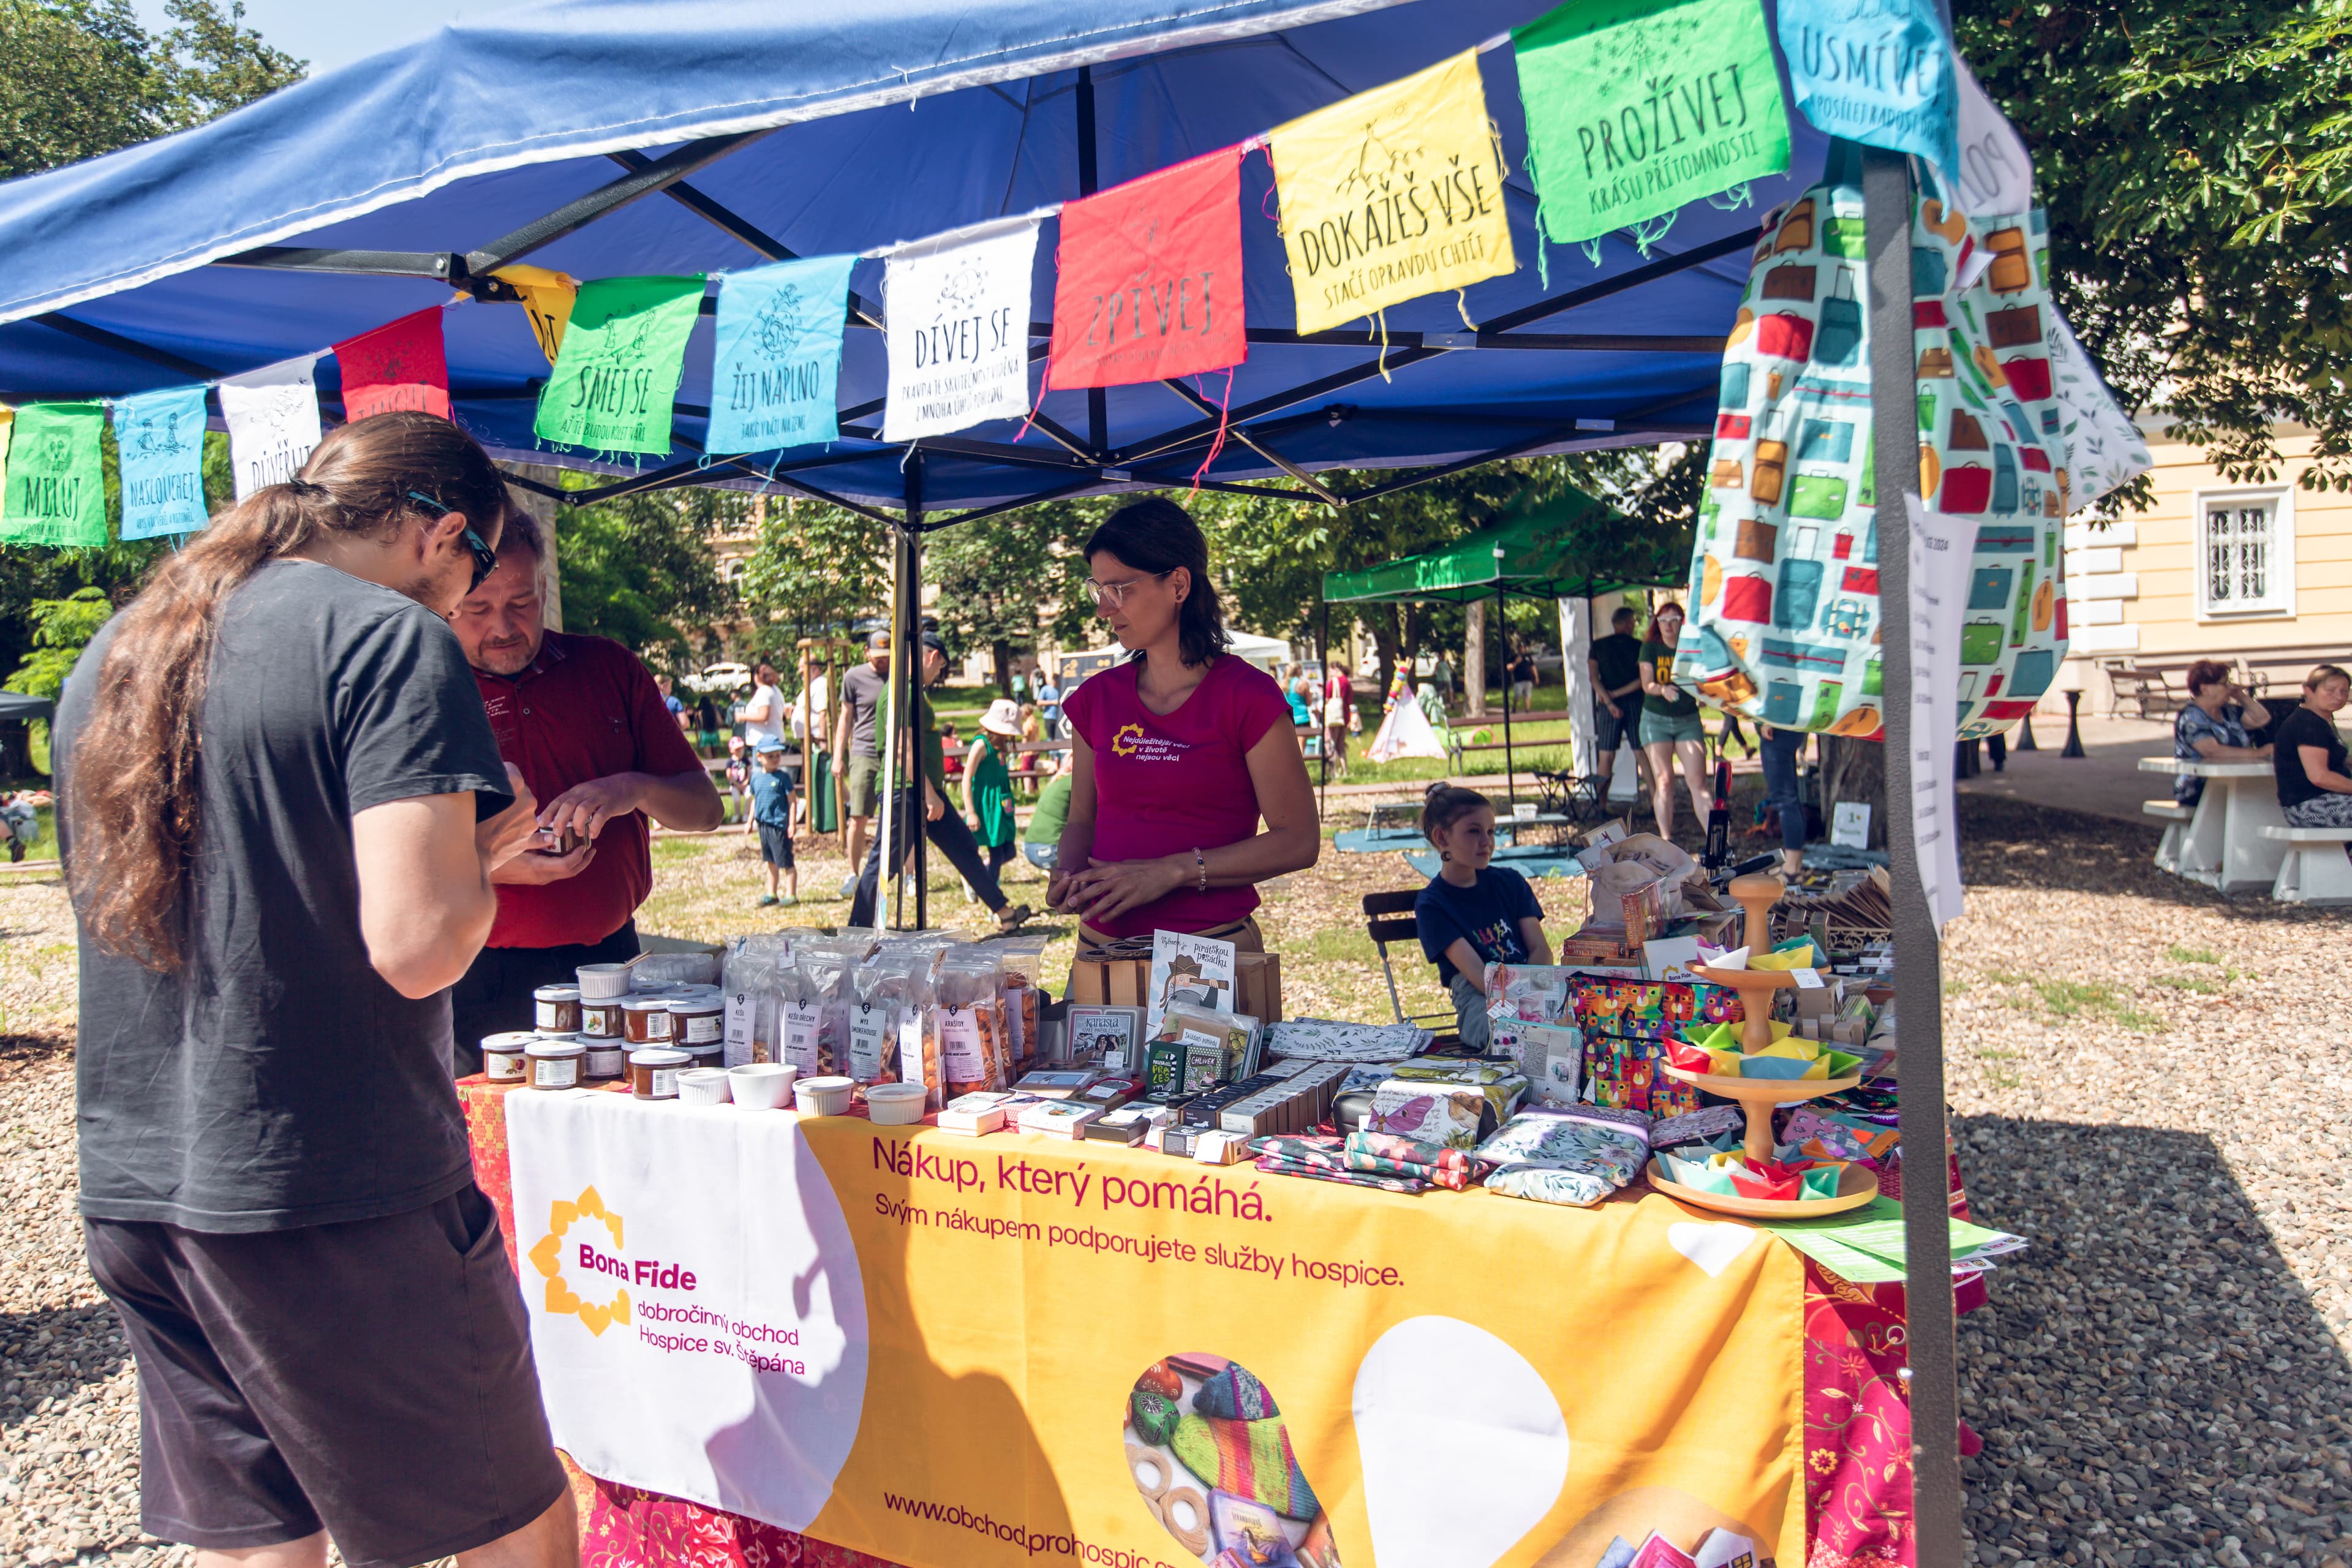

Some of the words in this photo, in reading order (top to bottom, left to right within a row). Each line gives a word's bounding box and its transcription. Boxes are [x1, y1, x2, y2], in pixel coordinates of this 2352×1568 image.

[1577, 64, 1747, 179] PROŽÍVEJ
[1817, 94, 1866, 125] POSÍLEJ
[1588, 175, 1643, 216] KRÁSU
[1645, 130, 1759, 197] PŘÍTOMNOSTI
[1300, 171, 1428, 277] DOKÁŽEŠ
[1431, 154, 1492, 226] VŠE
[1324, 265, 1366, 310] STAČÍ
[1369, 250, 1438, 291] OPRAVDU
[1441, 232, 1485, 266] CHTÍT
[1087, 270, 1215, 347] ZPÍVEJ
[915, 312, 982, 369] DÍVEJ
[990, 307, 1011, 352] SE
[570, 353, 629, 418] SMĚJ
[630, 366, 654, 414] SE
[731, 361, 757, 413] ŽIJ
[761, 361, 821, 408] NAPLNO
[902, 381, 932, 402] PRAVDA
[584, 423, 609, 440] BUDOU
[741, 421, 760, 440] JAKO
[922, 401, 952, 420] MNOHA
[24, 475, 80, 519] MILUJ
[129, 472, 195, 508] NASLOUCHEJ
[1123, 735, 1172, 746] Nejdůležitější
[1136, 753, 1161, 762] nejsou
[788, 1012, 798, 1020] KEŠU
[799, 1013, 815, 1022] OŘECHY
[851, 1025, 877, 1036] SMOKEHOUSE
[873, 1136, 986, 1193] Nákup,
[998, 1155, 1091, 1207] který
[1102, 1175, 1273, 1223] pomáhá.
[875, 1192, 928, 1226] Svým
[936, 1206, 1041, 1242] nákupem
[1049, 1225, 1197, 1265] podporujete
[1204, 1243, 1285, 1281] služby
[1292, 1251, 1405, 1289] hospice.
[579, 1243, 629, 1282] Bona
[635, 1259, 697, 1291] Fide
[638, 1300, 729, 1333] dobročinný
[732, 1321, 799, 1346] obchod
[640, 1324, 709, 1353] Hospice
[714, 1339, 735, 1357] sv.
[736, 1340, 805, 1376] Štěpána
